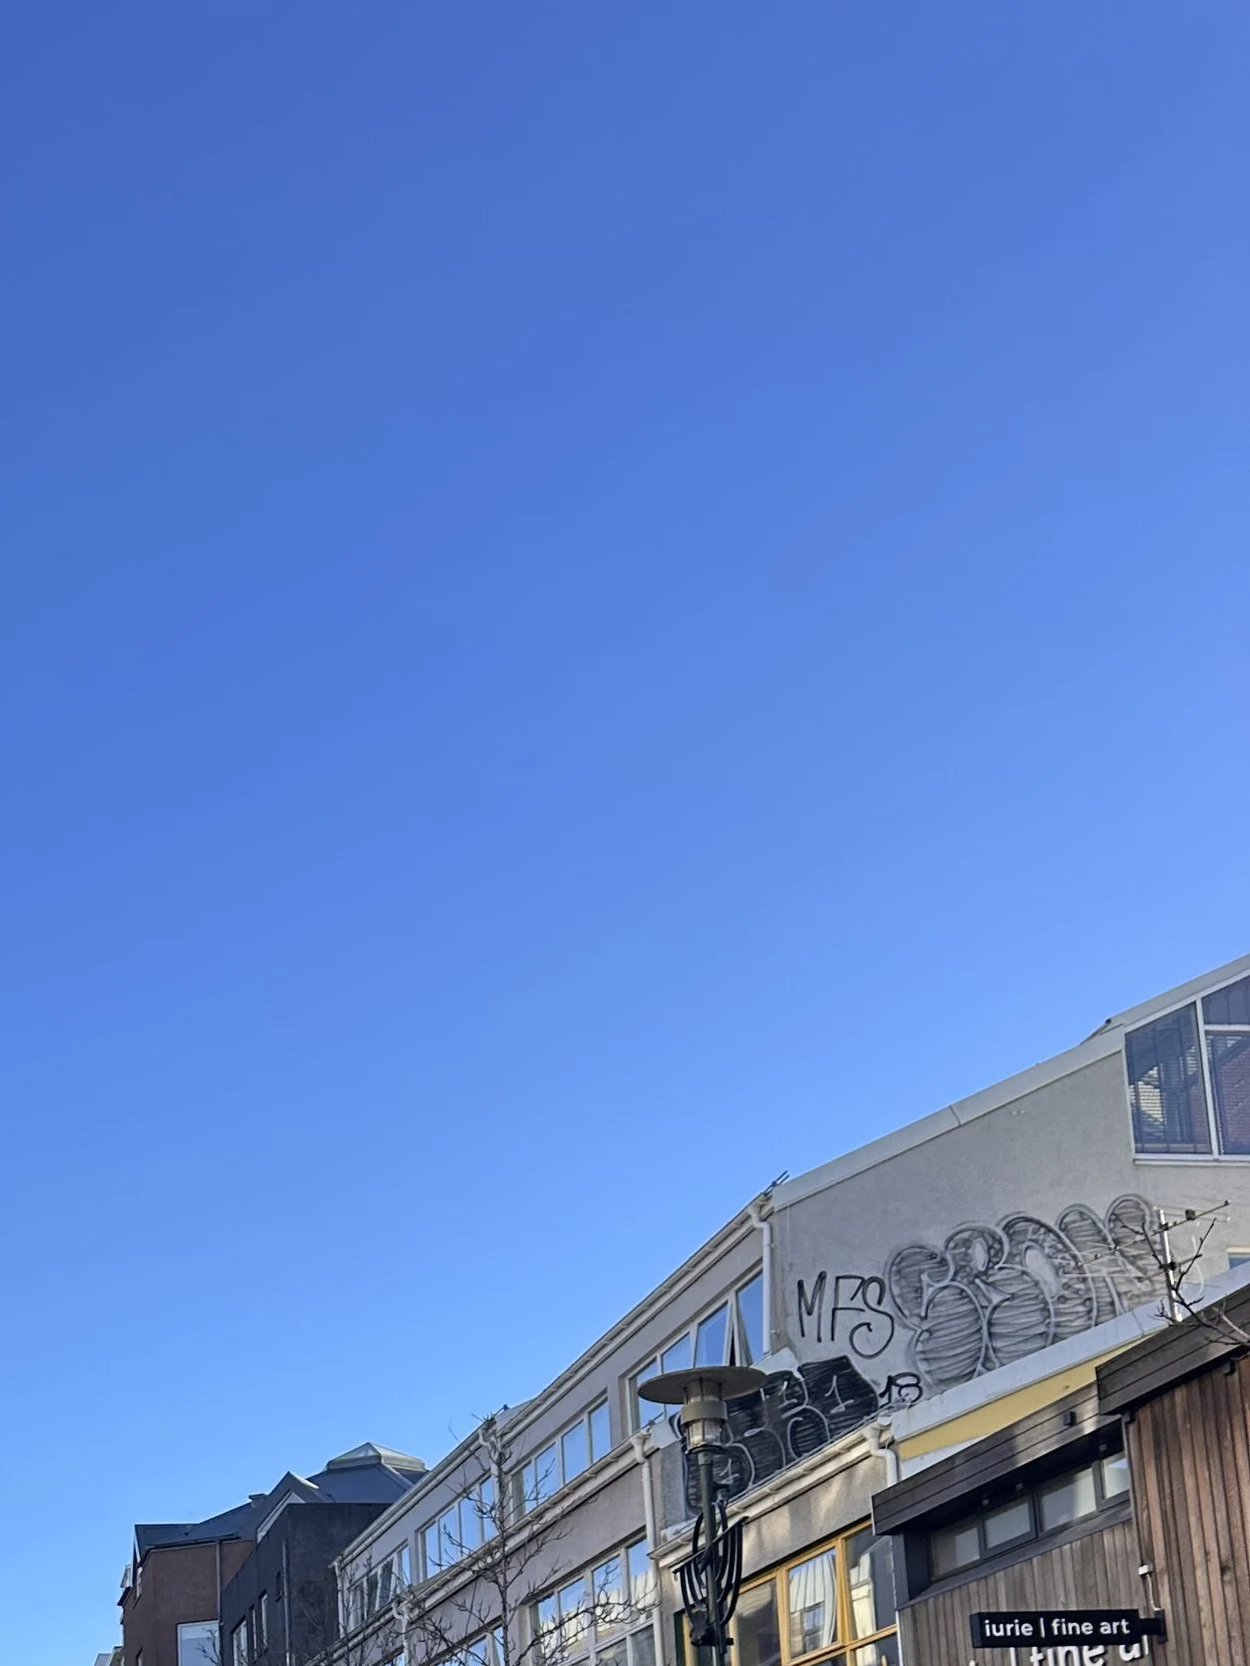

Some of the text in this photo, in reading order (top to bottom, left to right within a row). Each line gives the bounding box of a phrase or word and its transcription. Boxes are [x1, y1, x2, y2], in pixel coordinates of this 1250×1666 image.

[984, 1619, 1034, 1637] iurie
[1051, 1618, 1094, 1636] fine
[1100, 1618, 1131, 1635] art
